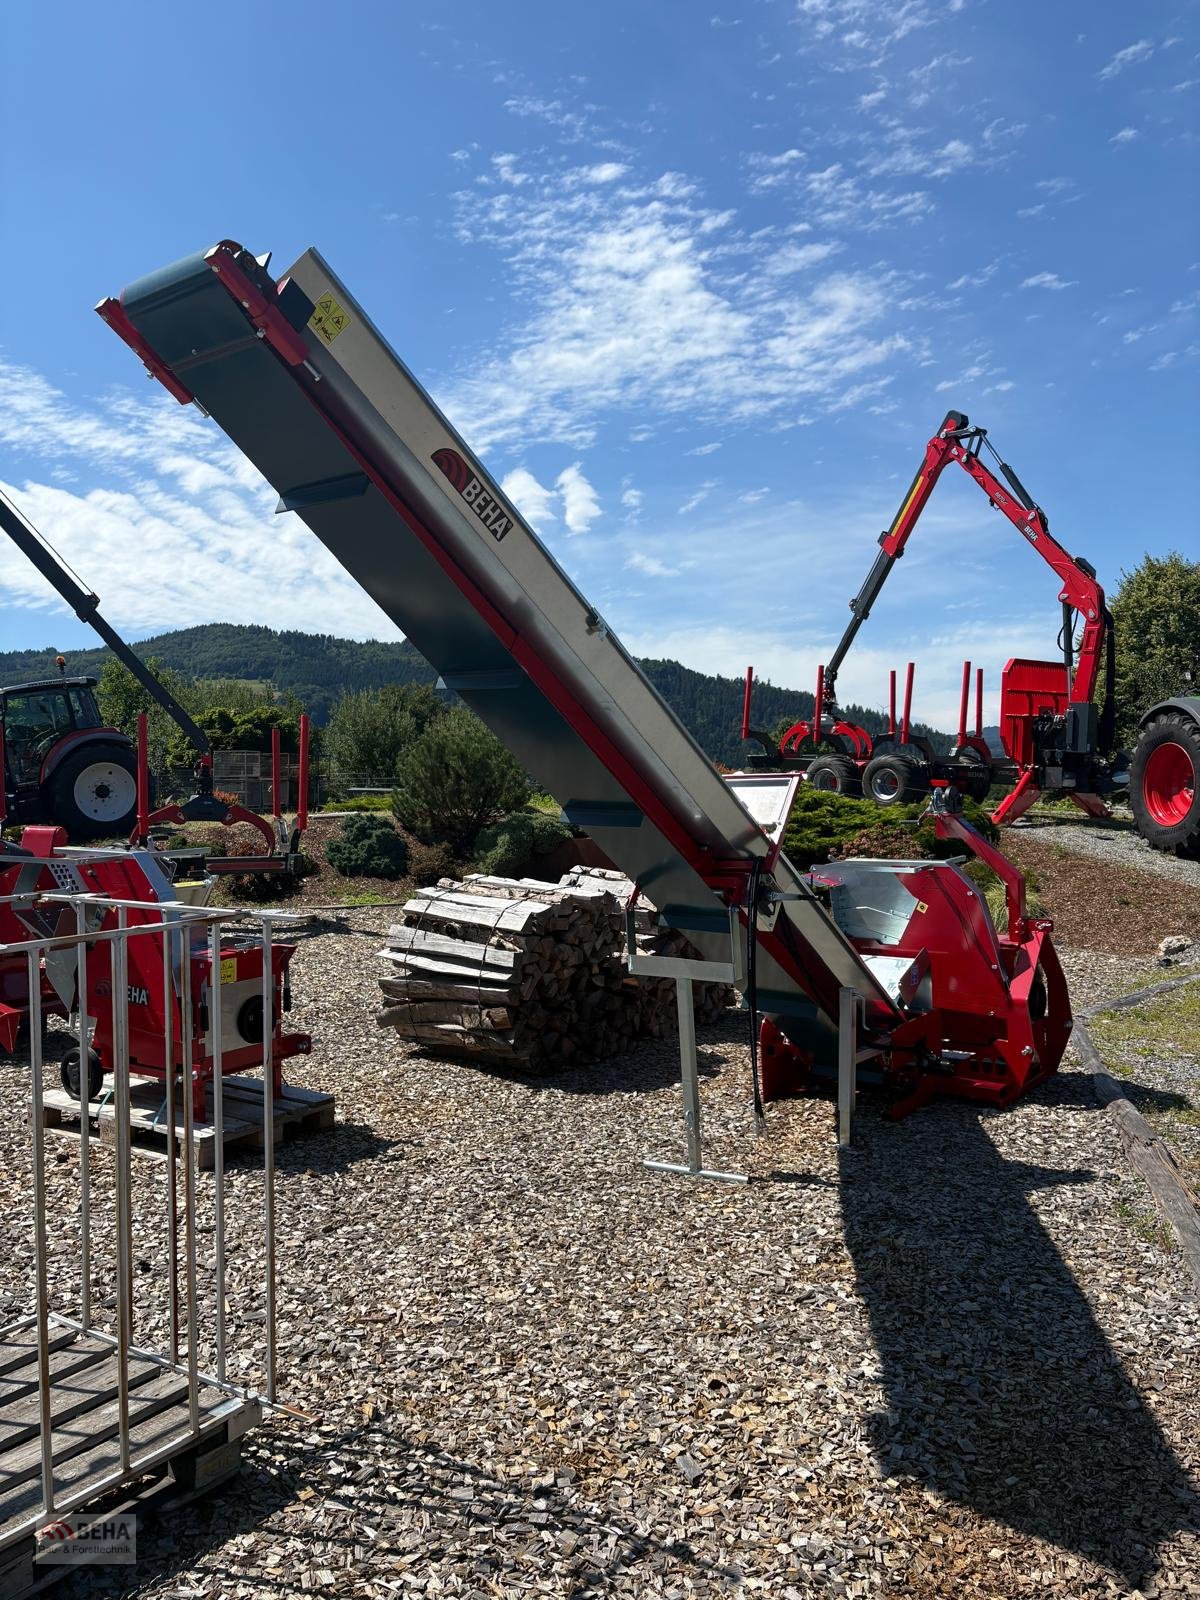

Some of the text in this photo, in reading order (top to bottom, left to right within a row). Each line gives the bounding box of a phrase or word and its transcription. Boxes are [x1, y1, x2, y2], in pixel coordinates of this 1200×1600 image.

[461, 478, 509, 539] BEHA
[1024, 525, 1038, 541] BEHA
[127, 985, 148, 1005] EHA
